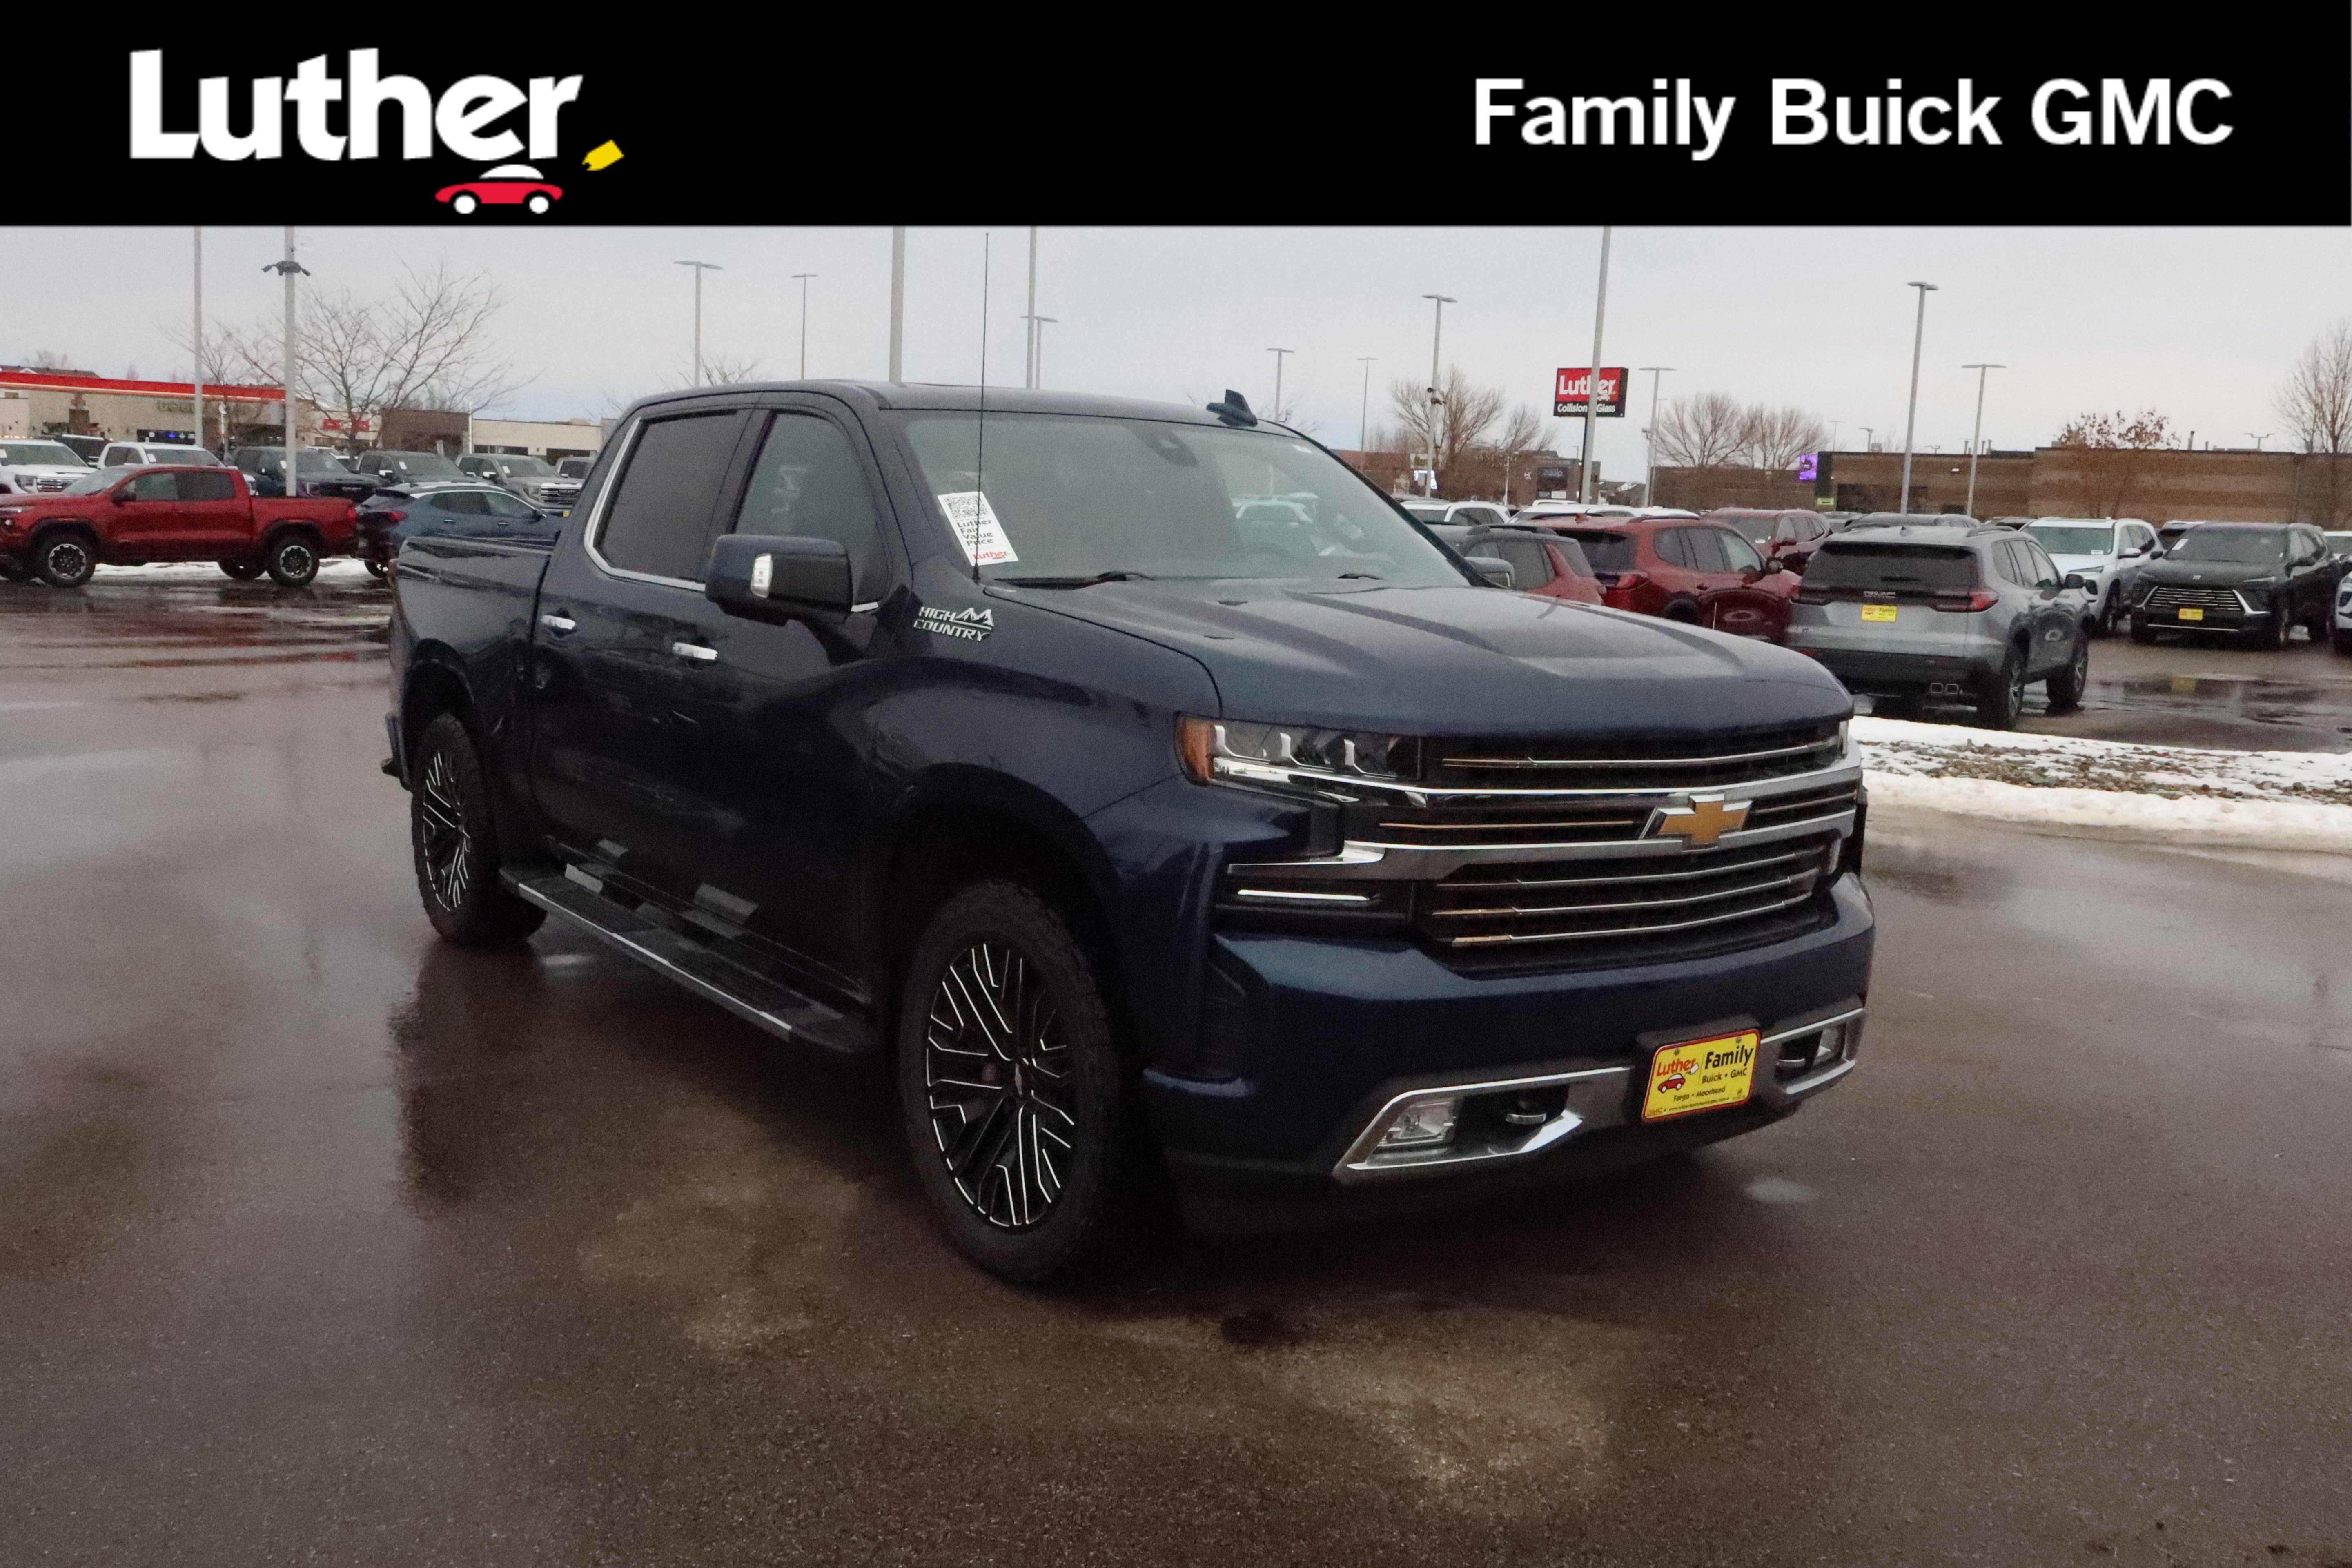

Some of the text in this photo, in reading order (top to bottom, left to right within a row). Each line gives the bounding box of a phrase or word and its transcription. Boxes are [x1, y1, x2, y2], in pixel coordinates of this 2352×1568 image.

[1557, 403, 1616, 412] Collision Glass
[957, 519, 991, 528] Luther
[919, 606, 957, 622] HIGH
[913, 619, 990, 642] COUNTRY
[1657, 1045, 1754, 1077] Luther Family
[1702, 1067, 1748, 1084] Buick GMC
